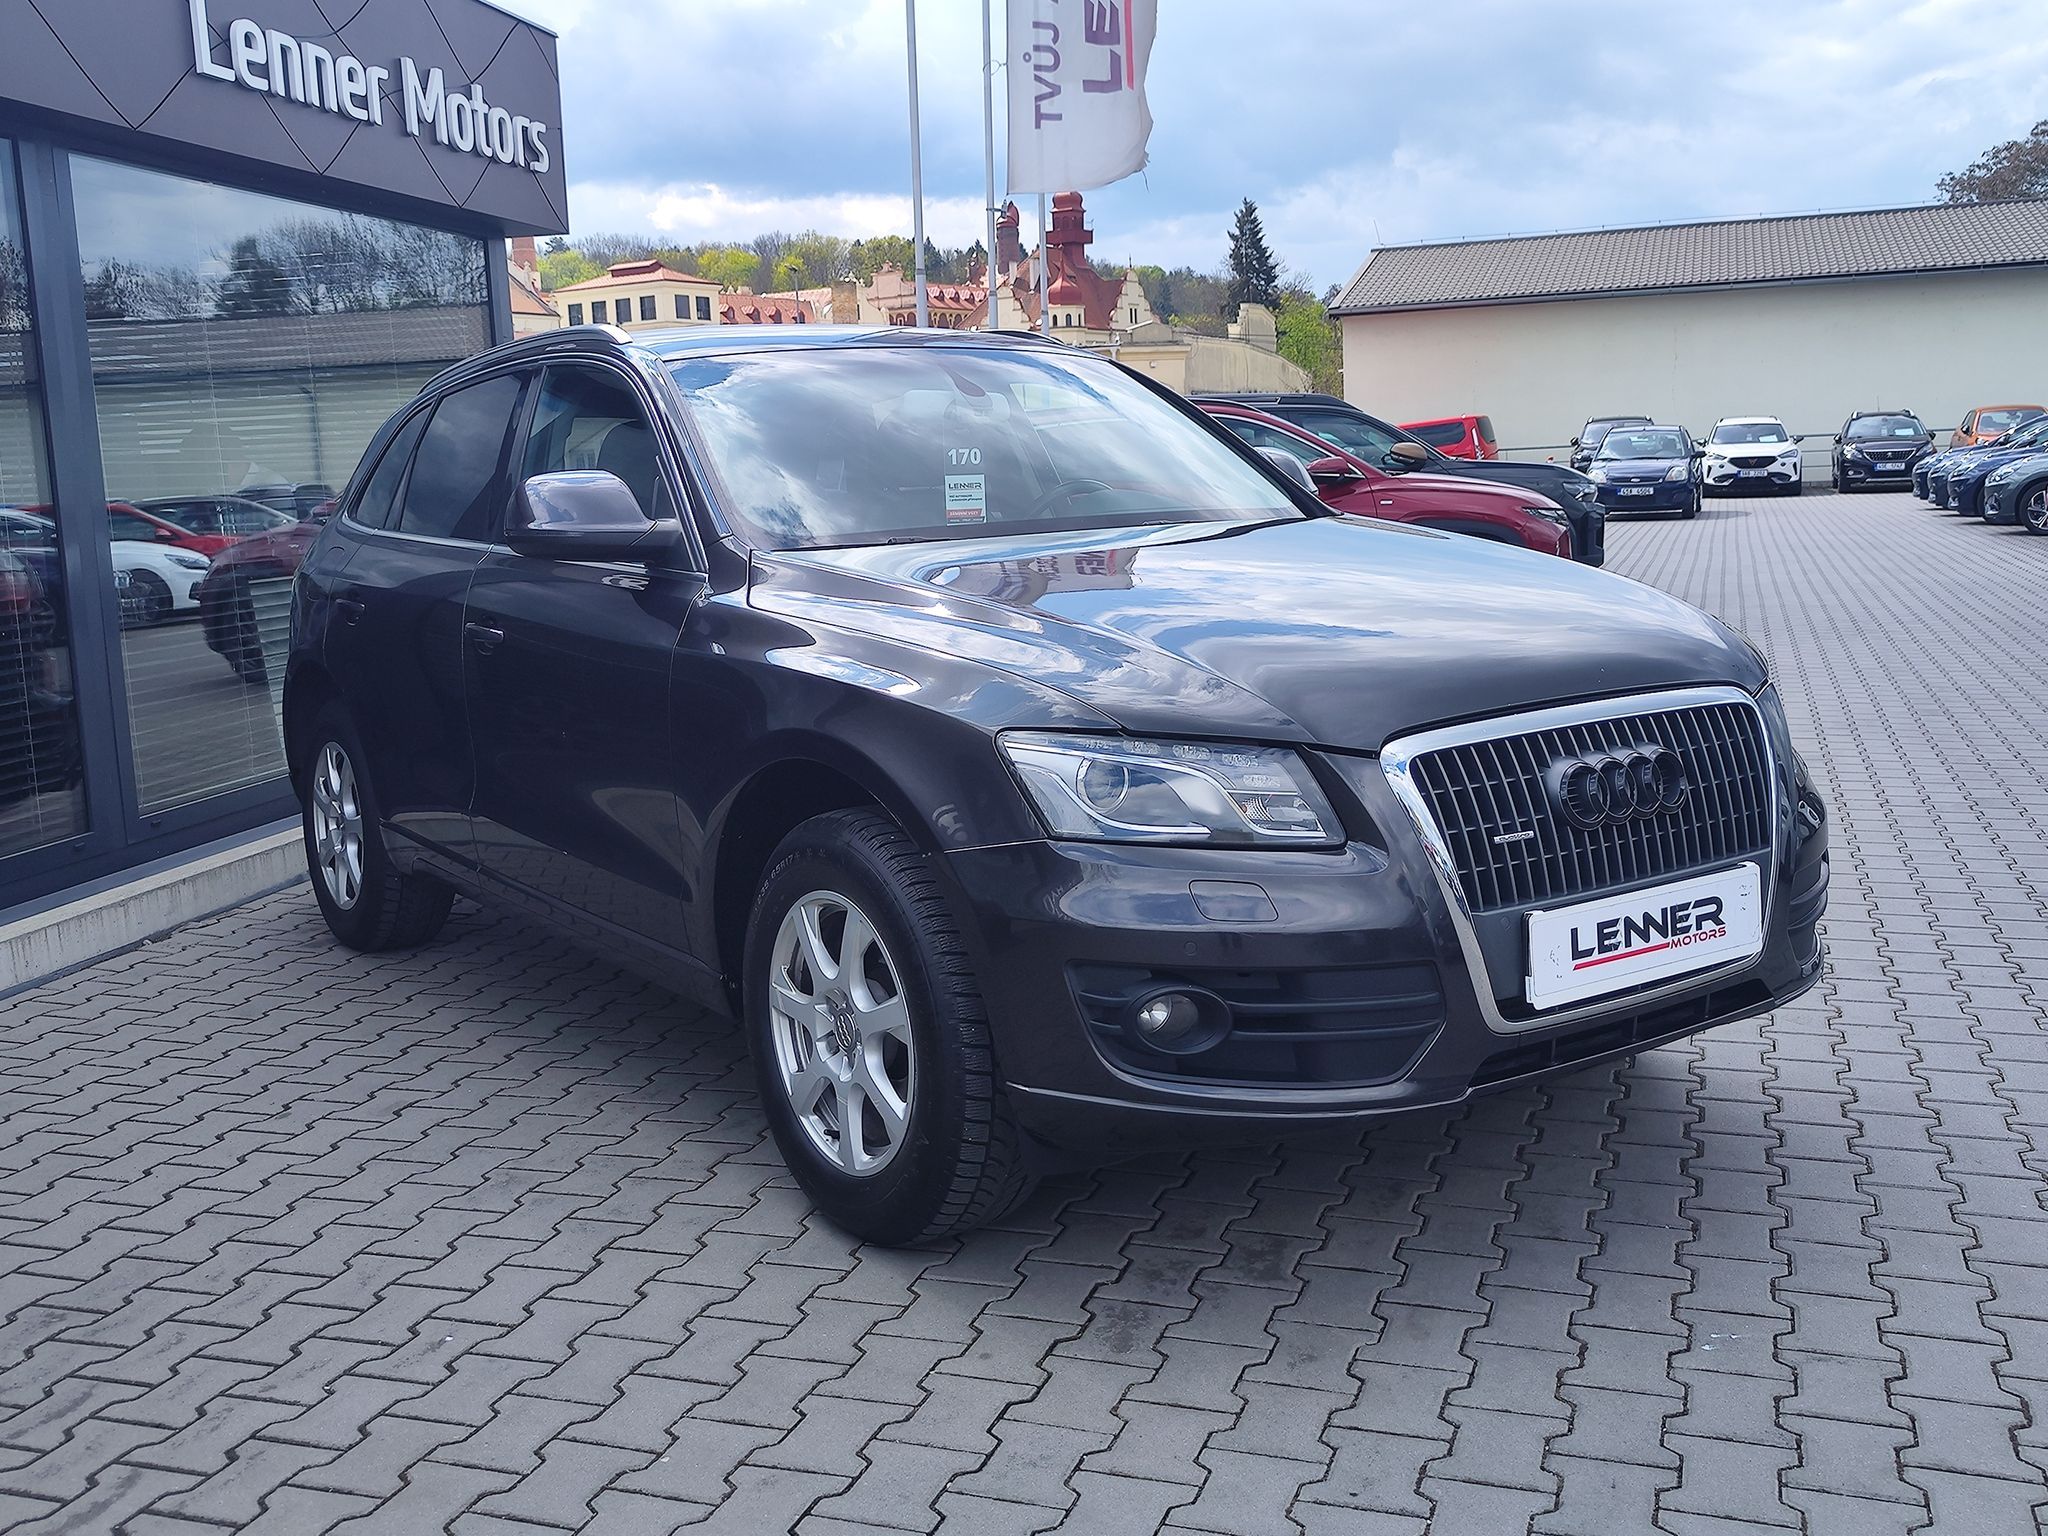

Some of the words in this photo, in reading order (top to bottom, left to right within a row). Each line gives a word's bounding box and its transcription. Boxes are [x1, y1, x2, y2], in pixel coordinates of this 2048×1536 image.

[190, 0, 389, 126] Lenner
[399, 56, 551, 173] Motors
[1023, 21, 1063, 130] TVŮJ
[948, 447, 982, 465] 170
[948, 482, 983, 490] LENNER
[1570, 896, 1726, 961] LENNER
[1670, 926, 1727, 950] MOTORS
